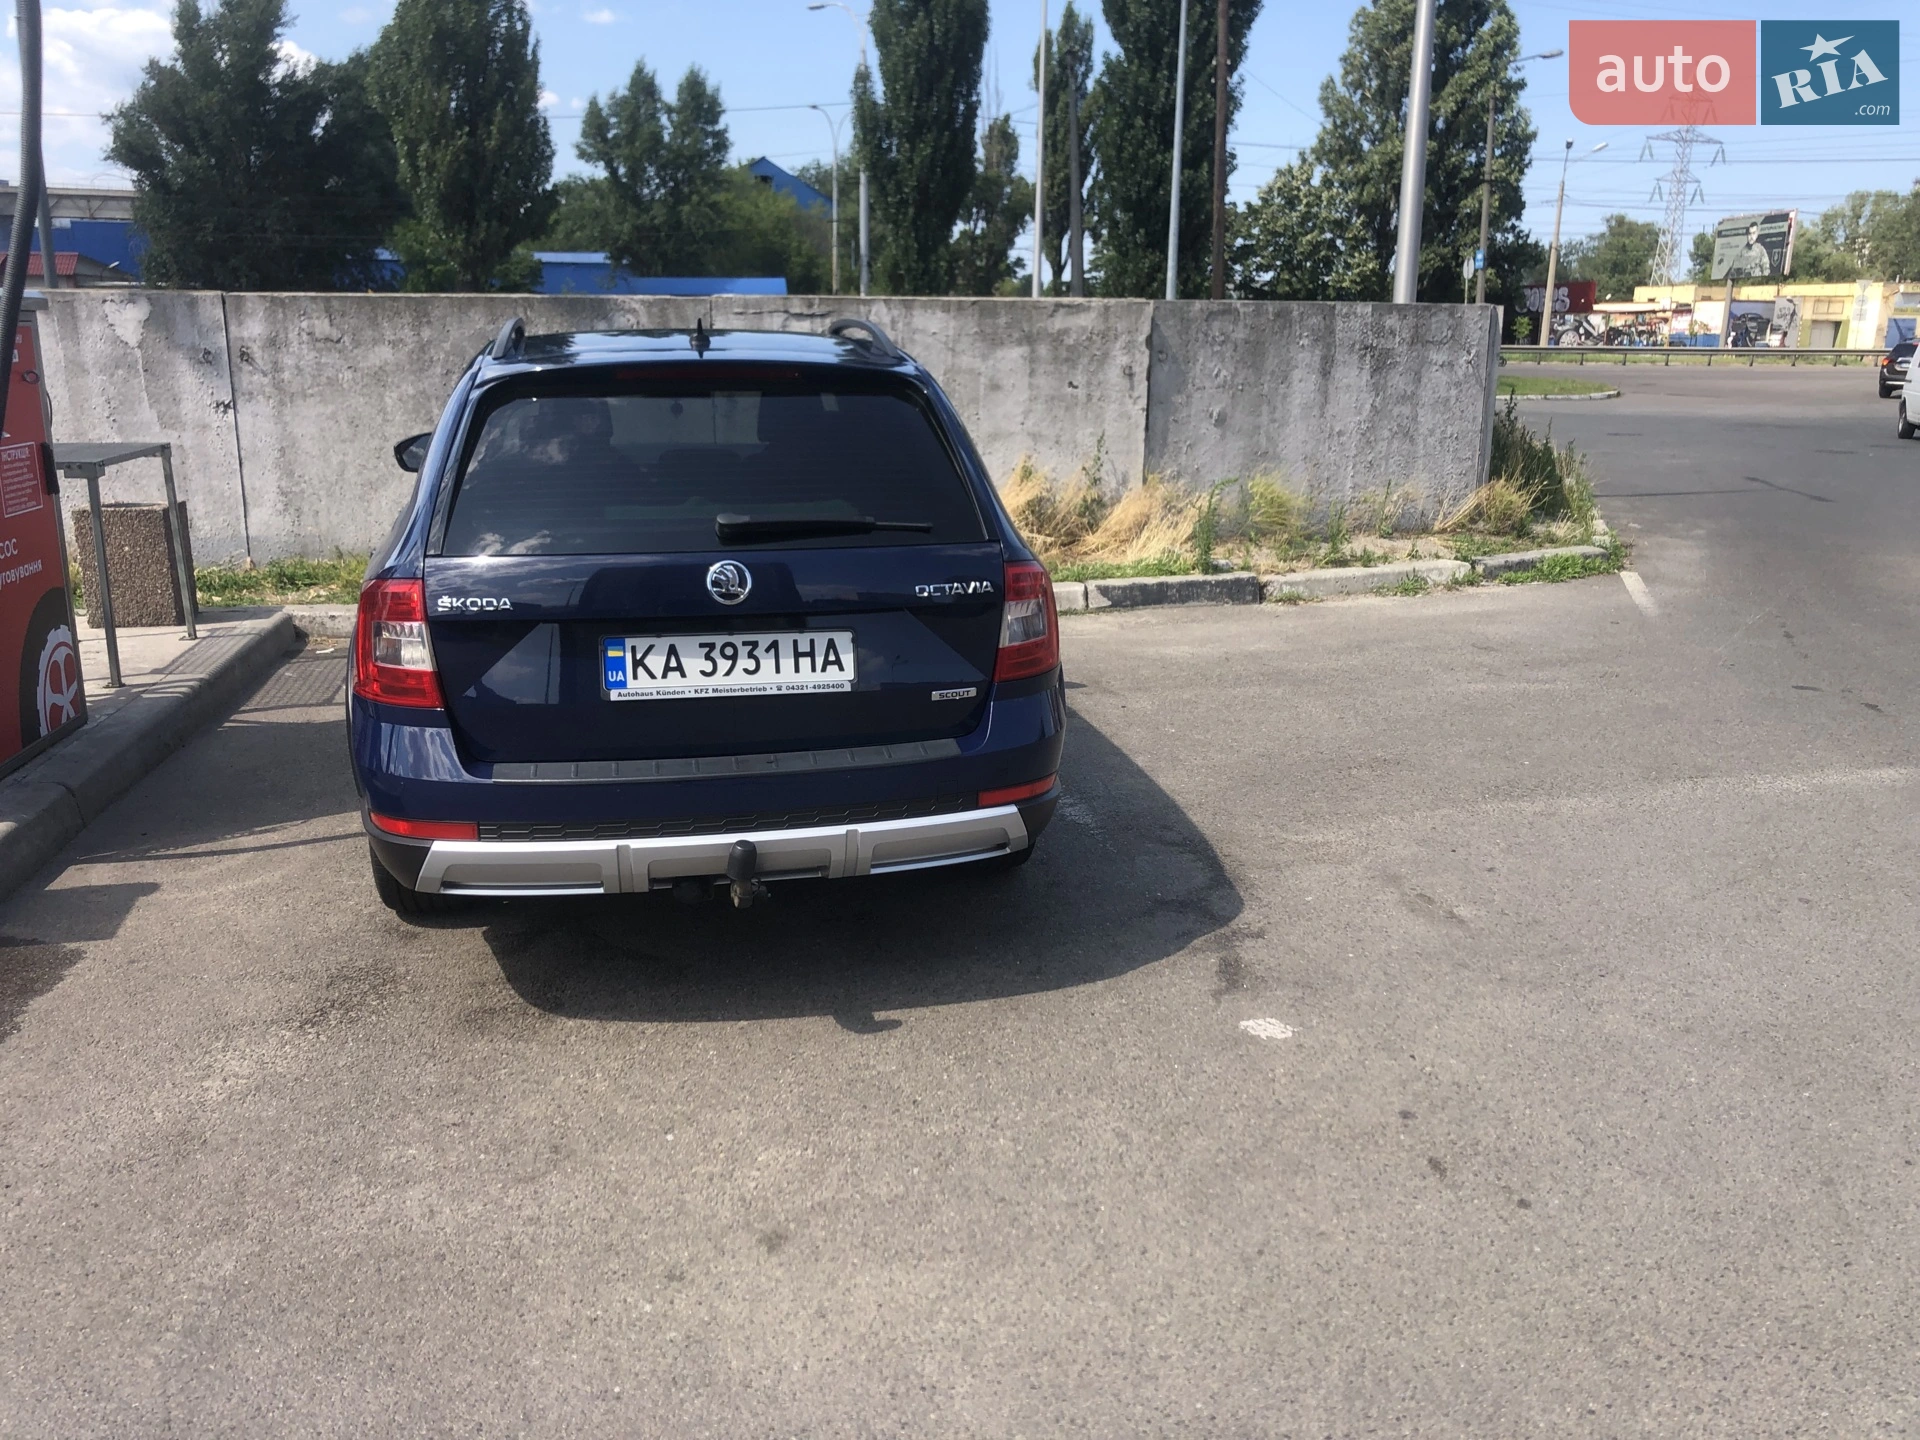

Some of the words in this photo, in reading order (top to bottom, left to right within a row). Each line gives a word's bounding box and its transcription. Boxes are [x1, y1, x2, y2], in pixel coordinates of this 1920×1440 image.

[915, 580, 994, 597] OCTAVIA
[437, 595, 513, 611] ŠKODA
[630, 643, 687, 680] KA
[698, 639, 781, 678] 3931
[792, 638, 845, 674] HA
[608, 670, 625, 682] UA
[711, 686, 767, 694] Meisterbetrieb
[938, 689, 971, 699] SCOUT
